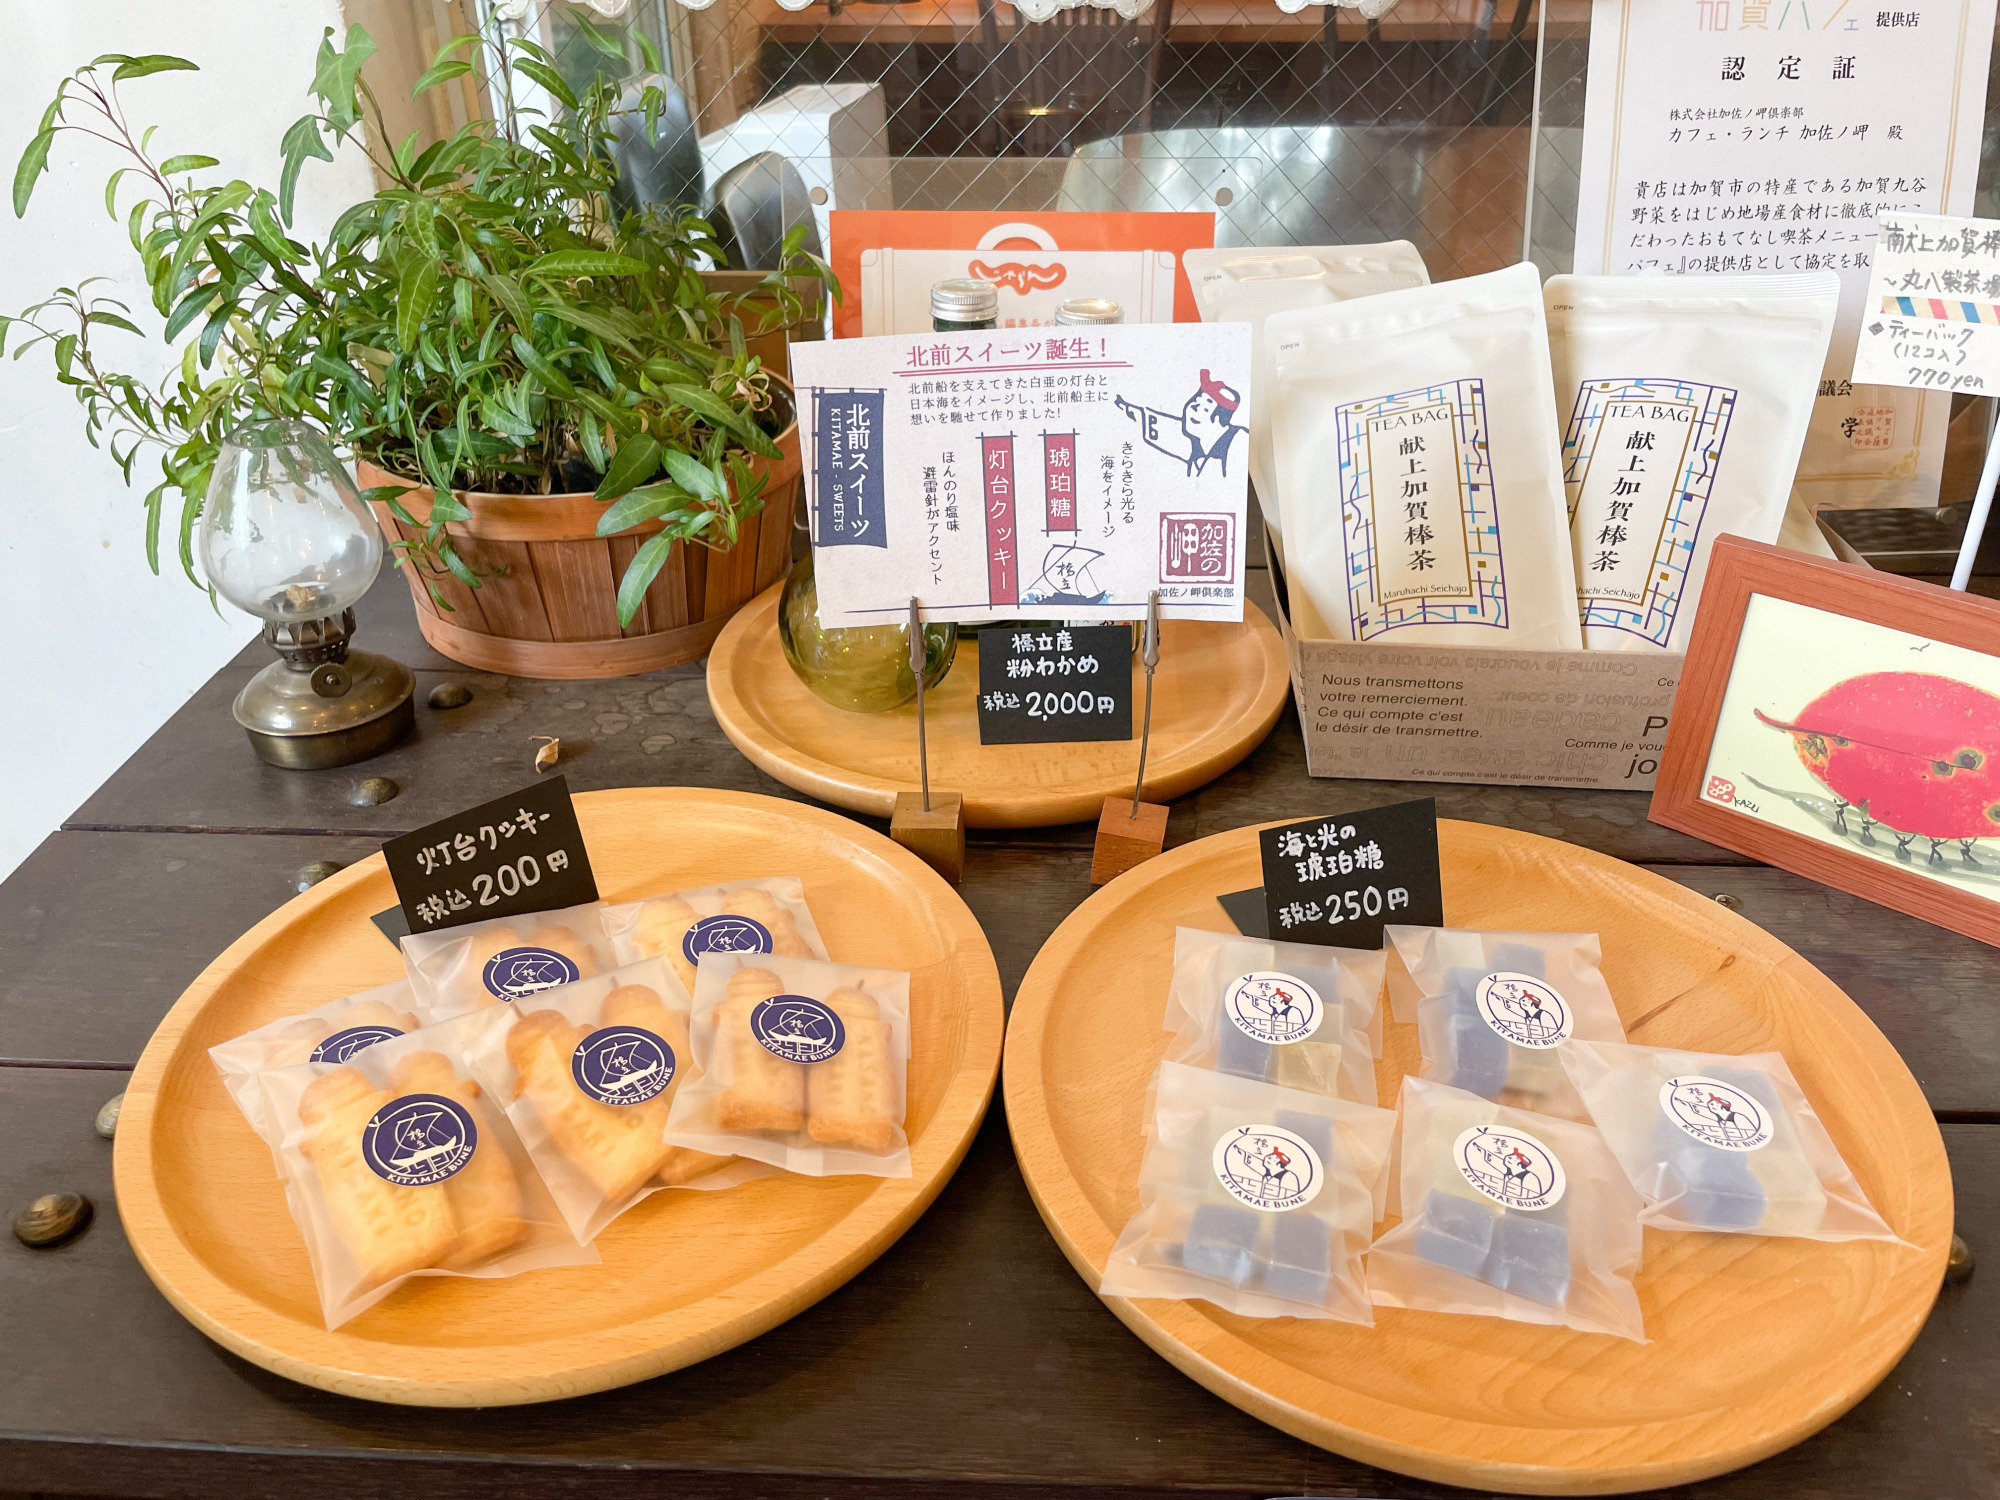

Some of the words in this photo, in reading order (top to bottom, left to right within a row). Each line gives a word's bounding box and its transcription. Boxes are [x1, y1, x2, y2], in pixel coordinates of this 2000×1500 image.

[1876, 12, 1920, 28] 提供店
[1721, 55, 1856, 81] 認定証
[1669, 126, 1789, 143] カフェ・ランチ
[1799, 124, 1869, 141] 加佐ノ岬
[1887, 124, 1904, 141] 殿
[1635, 177, 1926, 199] 貴店は加賀市の特産である加賀九谷
[1631, 203, 1921, 225] 野菜をはじめ地場産食材に徹底的
[1630, 227, 1878, 248] だわったおもてなし喫茶メニュー
[1203, 274, 1222, 282] OPEN
[1280, 343, 1299, 351] OPEN
[908, 374, 1108, 395] 北前船を支えてきた白亜の灯台と
[910, 390, 1109, 410] 日本海をイメージし、北前船主に
[1371, 416, 1407, 432] TEA
[1412, 408, 1448, 425] BAG
[1610, 405, 1645, 418] TEA
[1650, 406, 1690, 422] BAG
[830, 408, 843, 469] KITAMAE
[1841, 417, 1859, 438] 学
[846, 403, 871, 538] 北前スイーツ
[1121, 441, 1135, 524] きらきら光る
[942, 451, 960, 532] ほんのり塩味
[1049, 449, 1071, 518] 琥珀糖
[833, 483, 844, 532] SWEETS
[1100, 455, 1116, 538] 海をイメージ
[1399, 436, 1438, 572] 献上加賀棒茶
[1588, 430, 1656, 573] 献上加賀棒茶
[923, 466, 943, 586] 避雷針がアクセント
[988, 449, 1012, 590] 灯台クッキー
[1384, 584, 1428, 600] Maruhachi
[1430, 583, 1467, 594] Seichajo
[1602, 586, 1640, 600] Seichajo
[1012, 629, 1074, 653] 橋立産
[1006, 654, 1099, 679] 粉わかめ
[1322, 674, 1360, 686] Nous
[1366, 676, 1464, 689] transmettons
[1657, 677, 1674, 687] Ce
[1320, 692, 1356, 703] votre
[1361, 694, 1468, 706] remerciement.
[1318, 706, 1338, 717] Ce
[1343, 707, 1365, 719] qui
[1370, 710, 1424, 722] compte
[1429, 711, 1463, 722] c'est
[1315, 722, 1327, 732] le
[1333, 723, 1369, 733] désir
[1373, 724, 1390, 734] de
[1396, 725, 1483, 738] transmettre.
[1565, 738, 1617, 750] Comme
[1620, 741, 1633, 752] je
[1638, 743, 1665, 751] vou
[1733, 796, 1759, 813] KAZU
[417, 807, 550, 875] 灯台クッキー
[1278, 823, 1356, 857] 海と光の
[1295, 840, 1384, 882] 琥珀糖
[1234, 1017, 1281, 1041] KITAMAE
[1284, 1026, 1311, 1041] BUNE
[1491, 1019, 1540, 1045] KITAMAE
[760, 1039, 808, 1061] KITAMAE
[809, 1047, 836, 1061] BUNE
[599, 1090, 655, 1104] KITAMAE
[654, 1067, 672, 1091] BUNE
[1682, 1124, 1741, 1148] KITAMAE
[1742, 1132, 1768, 1148] BUNE
[387, 1169, 448, 1185] KITAMAE
[448, 1145, 473, 1171] BUNE
[1221, 1174, 1270, 1208] KITAMAE
[1274, 1195, 1306, 1208] BUNE
[1462, 1167, 1513, 1204] KITAMAE
[1516, 1198, 1549, 1208] BUNE
